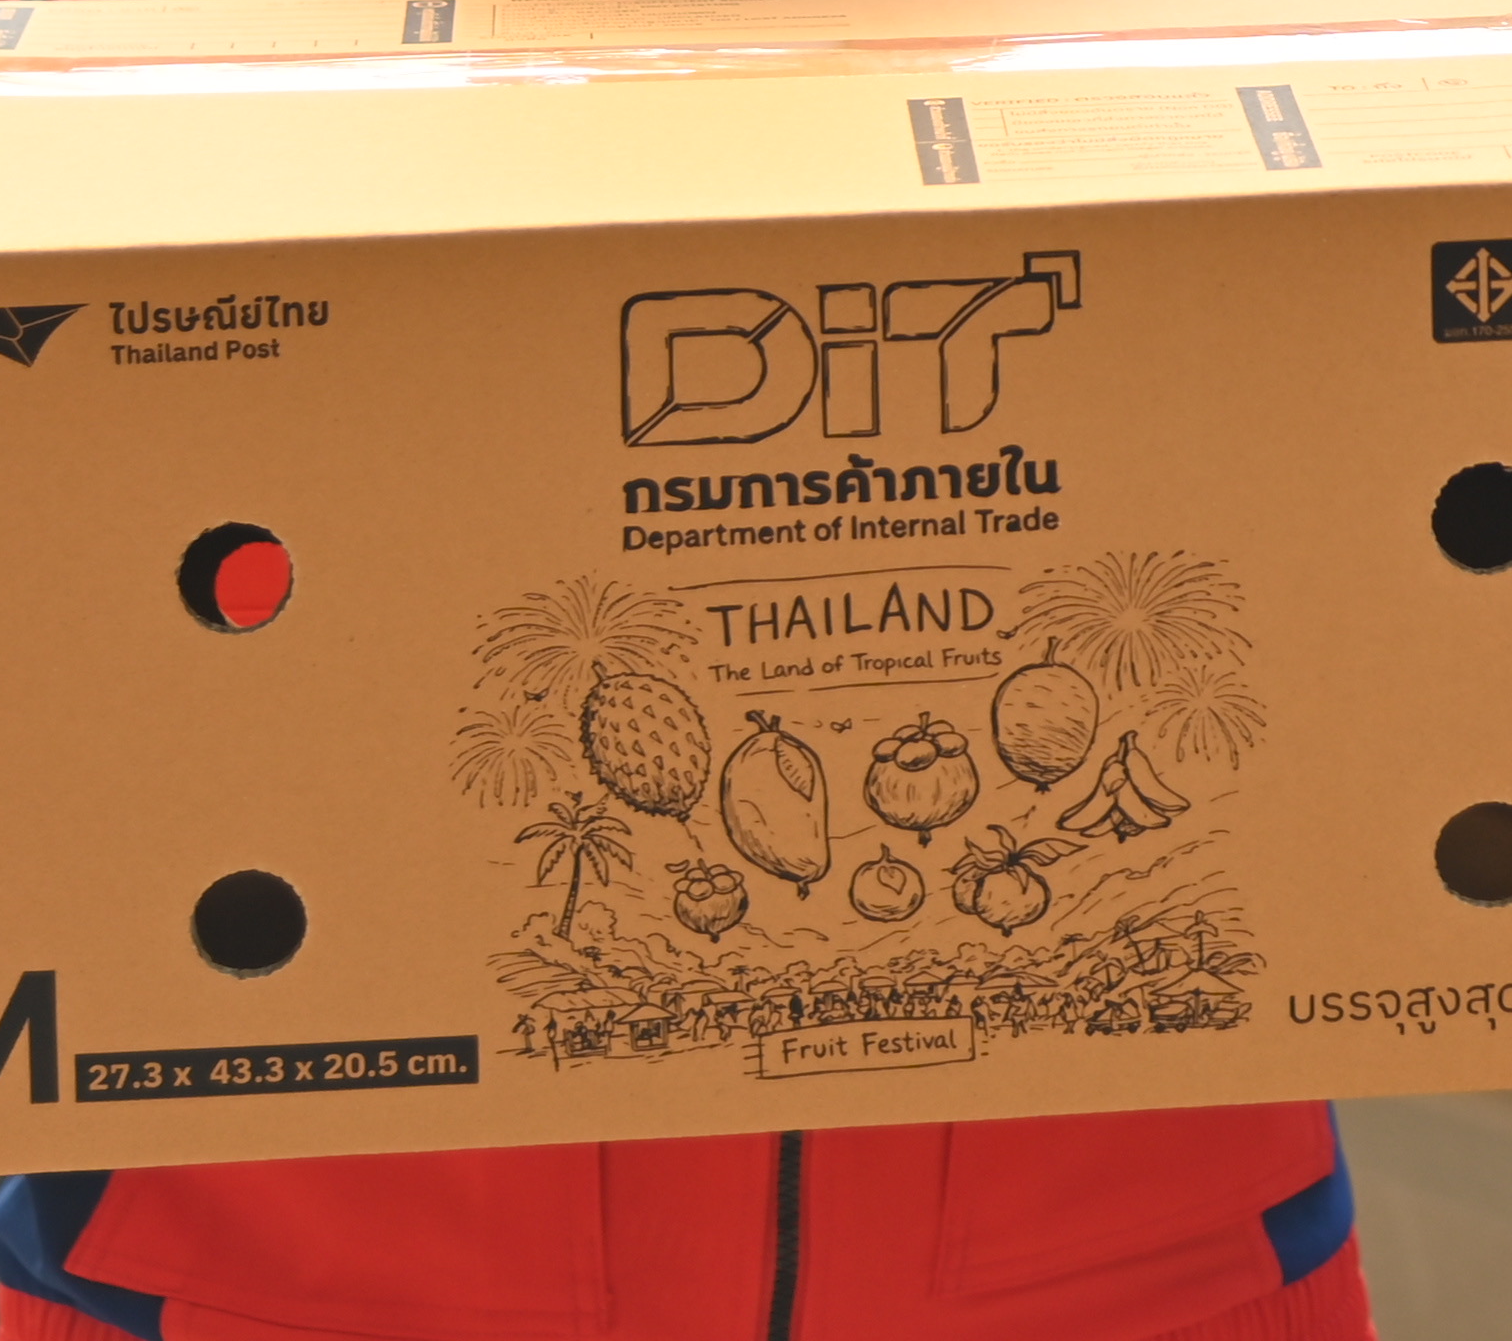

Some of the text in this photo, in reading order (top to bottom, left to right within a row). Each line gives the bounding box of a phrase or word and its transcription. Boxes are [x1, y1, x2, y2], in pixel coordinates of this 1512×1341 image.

[971, 97, 1060, 106] VERIFIED
[108, 294, 330, 335] ไปรษณีย์ไทย
[111, 338, 280, 365] Thailand Post
[620, 249, 1083, 447] DiT
[623, 444, 1062, 513] กรมการค้าภายใน
[623, 505, 1060, 555] Department of Internal Trade
[706, 581, 995, 647] THAILAND
[708, 647, 1003, 683] The Land of Tropical Fruits
[782, 1029, 957, 1064] Fruit Festival
[88, 1051, 468, 1091] 27.3 x 43.3 x 20.5 cm.
